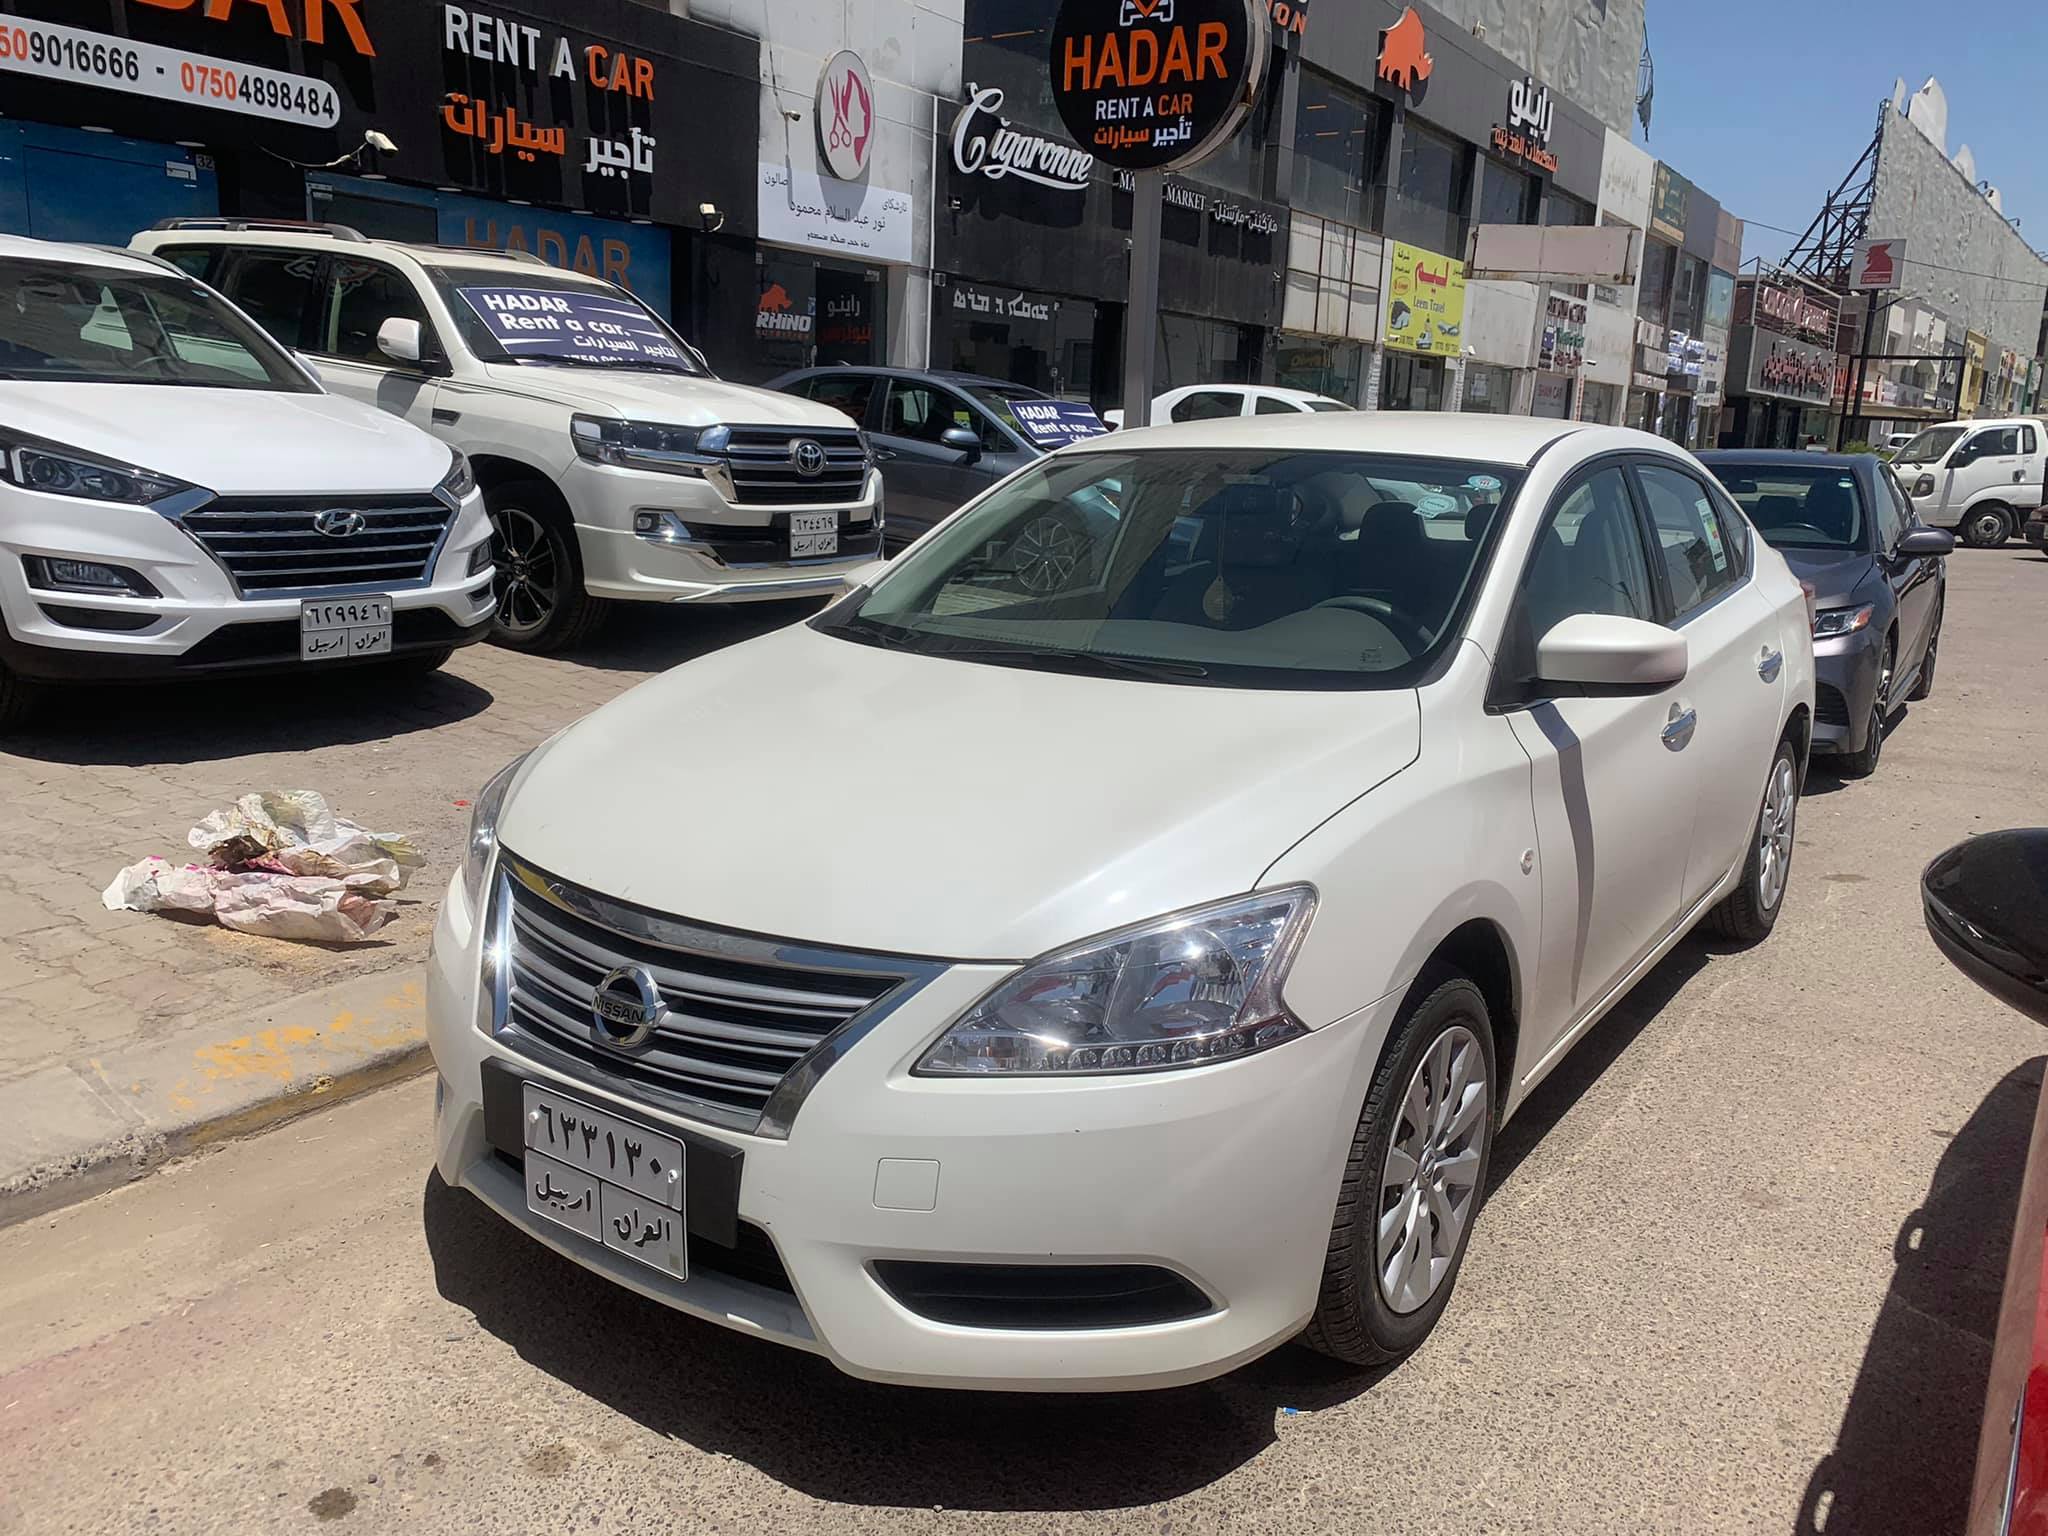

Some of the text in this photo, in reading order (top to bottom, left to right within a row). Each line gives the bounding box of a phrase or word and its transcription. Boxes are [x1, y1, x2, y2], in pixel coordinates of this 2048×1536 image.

[445, 4, 655, 101] RENT A CAR
[1063, 22, 1229, 92] HADAR
[181, 62, 334, 120] 07504898484
[1095, 93, 1193, 121] RENT A CAR
[1509, 77, 1554, 143] راينو
[441, 92, 657, 180] تأجير سيارات
[952, 82, 1094, 190] Cigaronne
[1094, 116, 1193, 150] تأجير سيارات
[790, 200, 821, 216] محمود
[1166, 185, 1207, 211] MARKET
[481, 294, 573, 314] HADAR
[497, 312, 632, 337] Rent a car.
[573, 335, 640, 352] السيارات
[1016, 405, 1061, 420] HADAR
[1027, 421, 1061, 435] Rent
[1060, 424, 1071, 433] a
[310, 604, 381, 625] ٦٢٩٩٤٦
[308, 635, 344, 653] اربيل
[593, 995, 645, 1024] NISSAN
[539, 1103, 662, 1178] ٦٣٣١٣٠
[536, 1172, 592, 1213] اربيل
